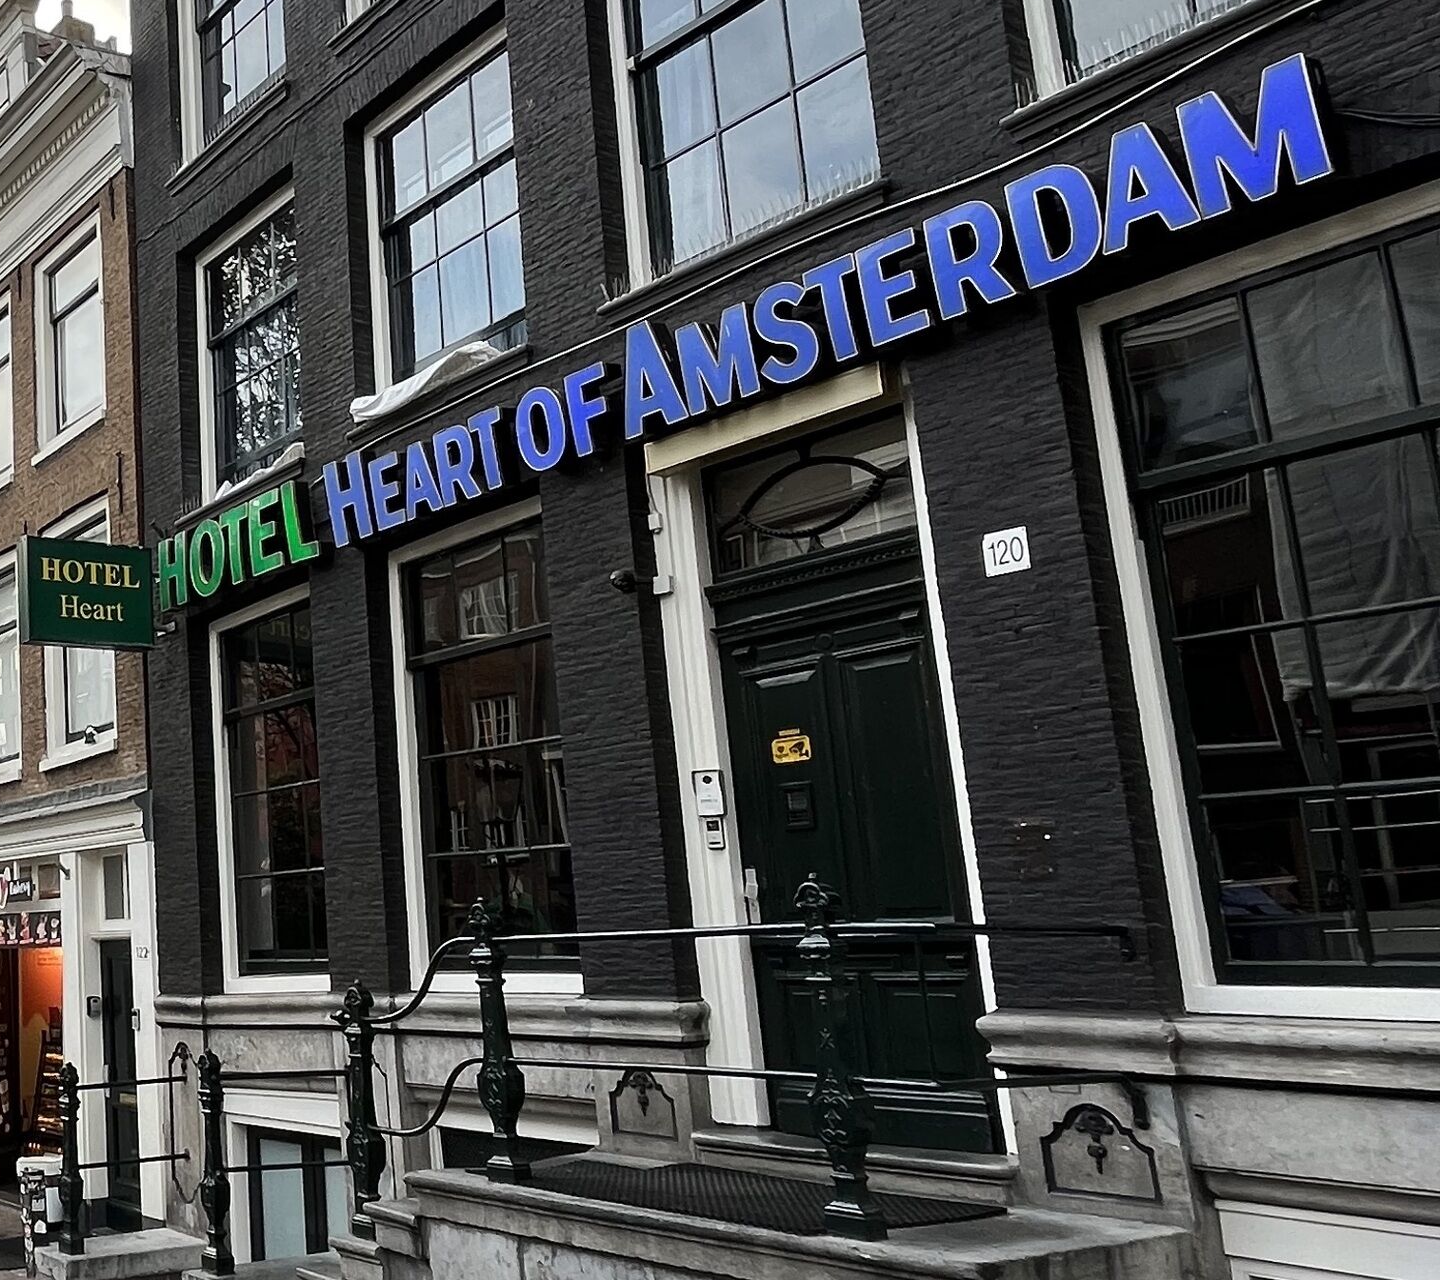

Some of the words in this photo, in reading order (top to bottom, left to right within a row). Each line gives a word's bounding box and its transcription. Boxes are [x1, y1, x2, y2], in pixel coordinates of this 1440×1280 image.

[158, 480, 320, 613] HOTEL
[323, 405, 503, 549] HEART
[515, 361, 608, 471] OF
[624, 52, 1335, 441] AMSTERDAM
[987, 536, 1024, 567] 120
[40, 556, 140, 589] HOTEL
[60, 593, 125, 622] Heart
[135, 946, 149, 959] 122
